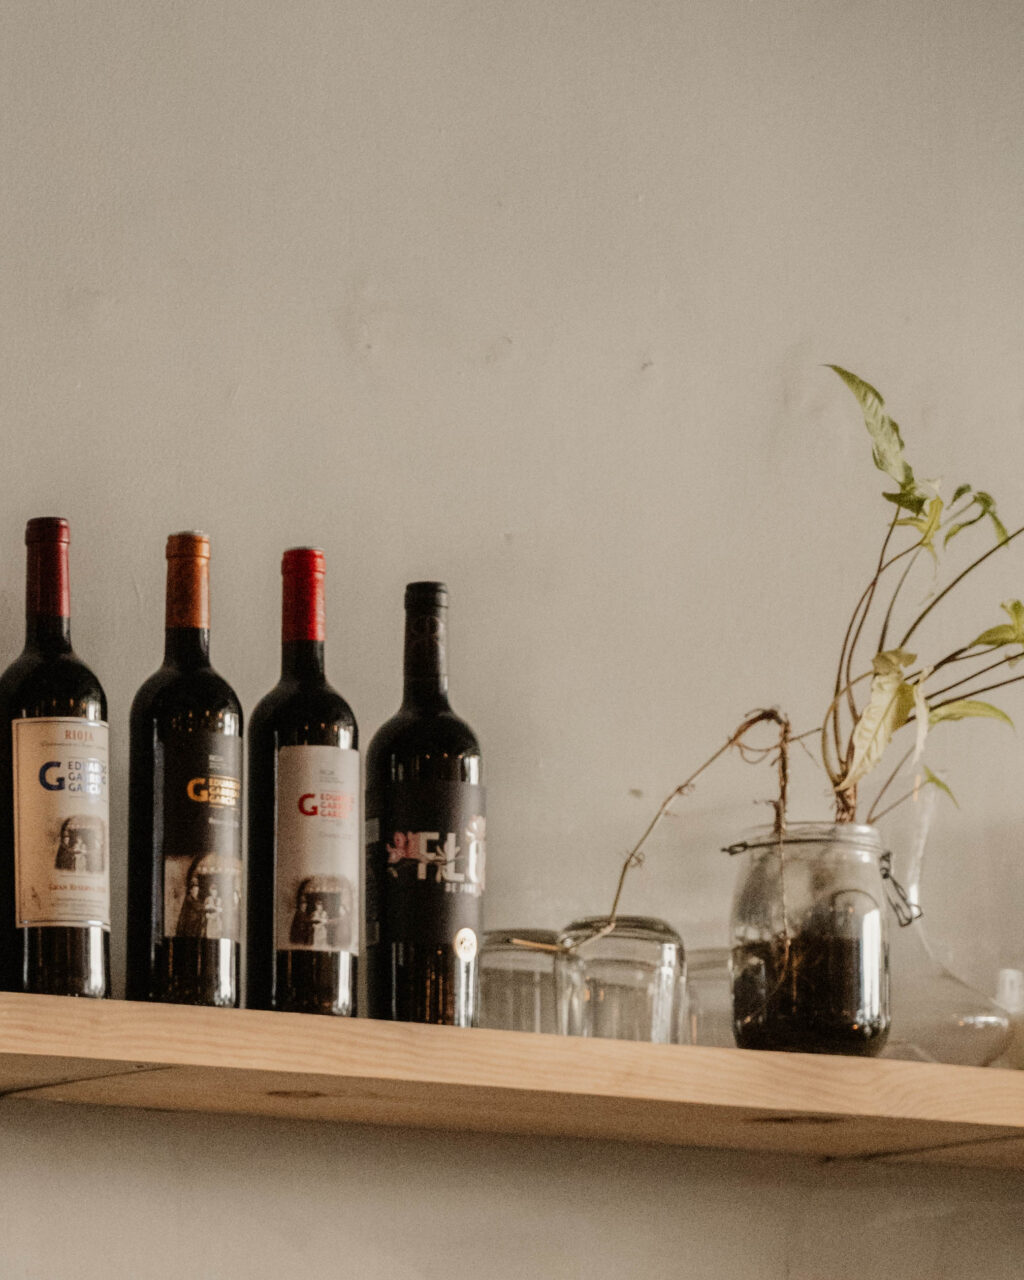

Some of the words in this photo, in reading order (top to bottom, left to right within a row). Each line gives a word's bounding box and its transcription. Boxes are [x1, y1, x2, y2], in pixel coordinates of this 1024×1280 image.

[65, 729, 95, 741] RIOJA
[39, 761, 65, 791] G
[187, 777, 209, 802] G
[298, 793, 318, 817] G
